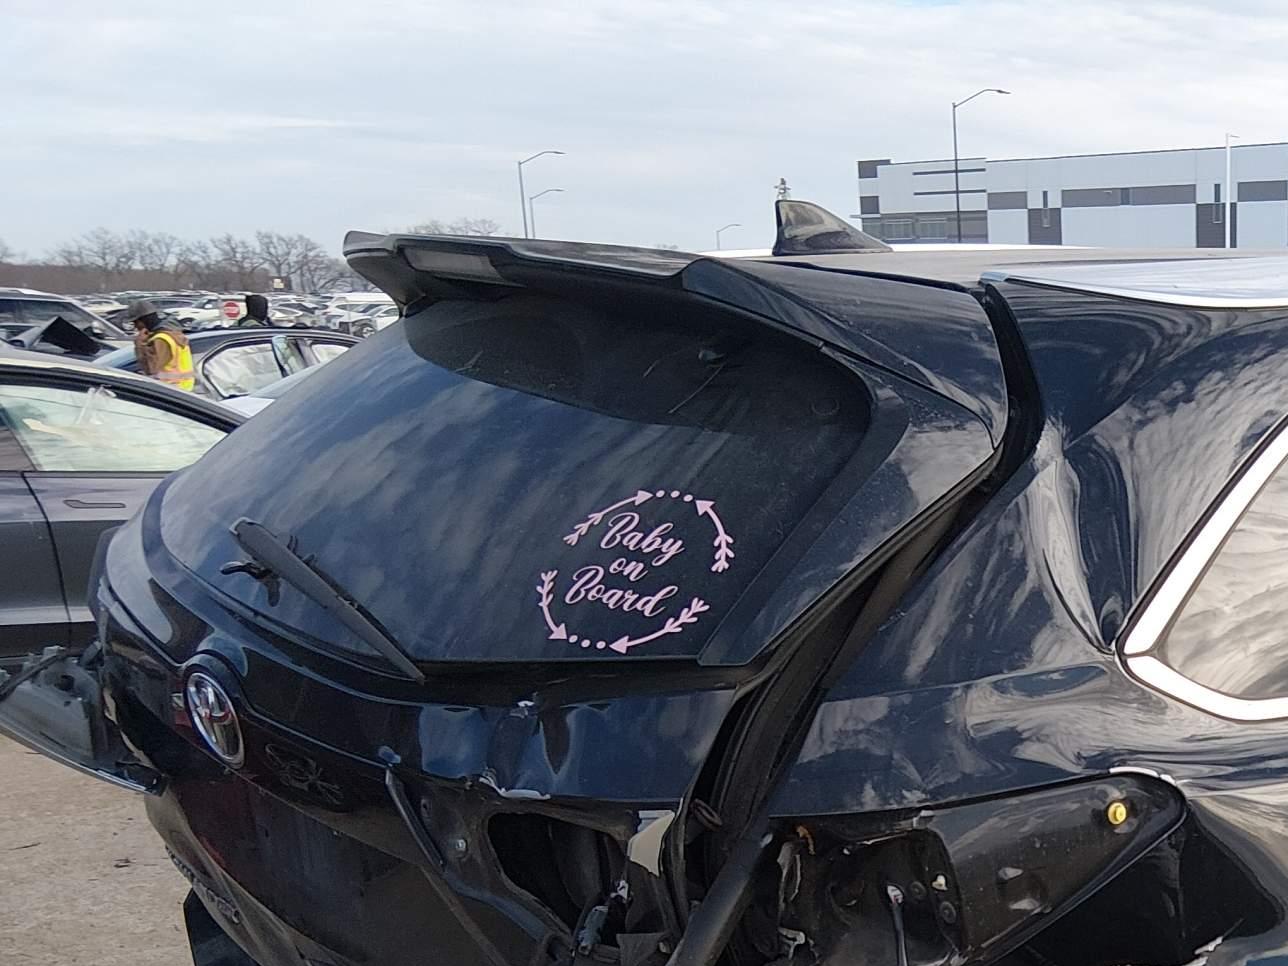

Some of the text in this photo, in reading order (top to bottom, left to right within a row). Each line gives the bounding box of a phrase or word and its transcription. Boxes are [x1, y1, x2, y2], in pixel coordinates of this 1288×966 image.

[600, 512, 684, 567] Baby
[564, 565, 678, 617] Board
[609, 557, 648, 581] on
